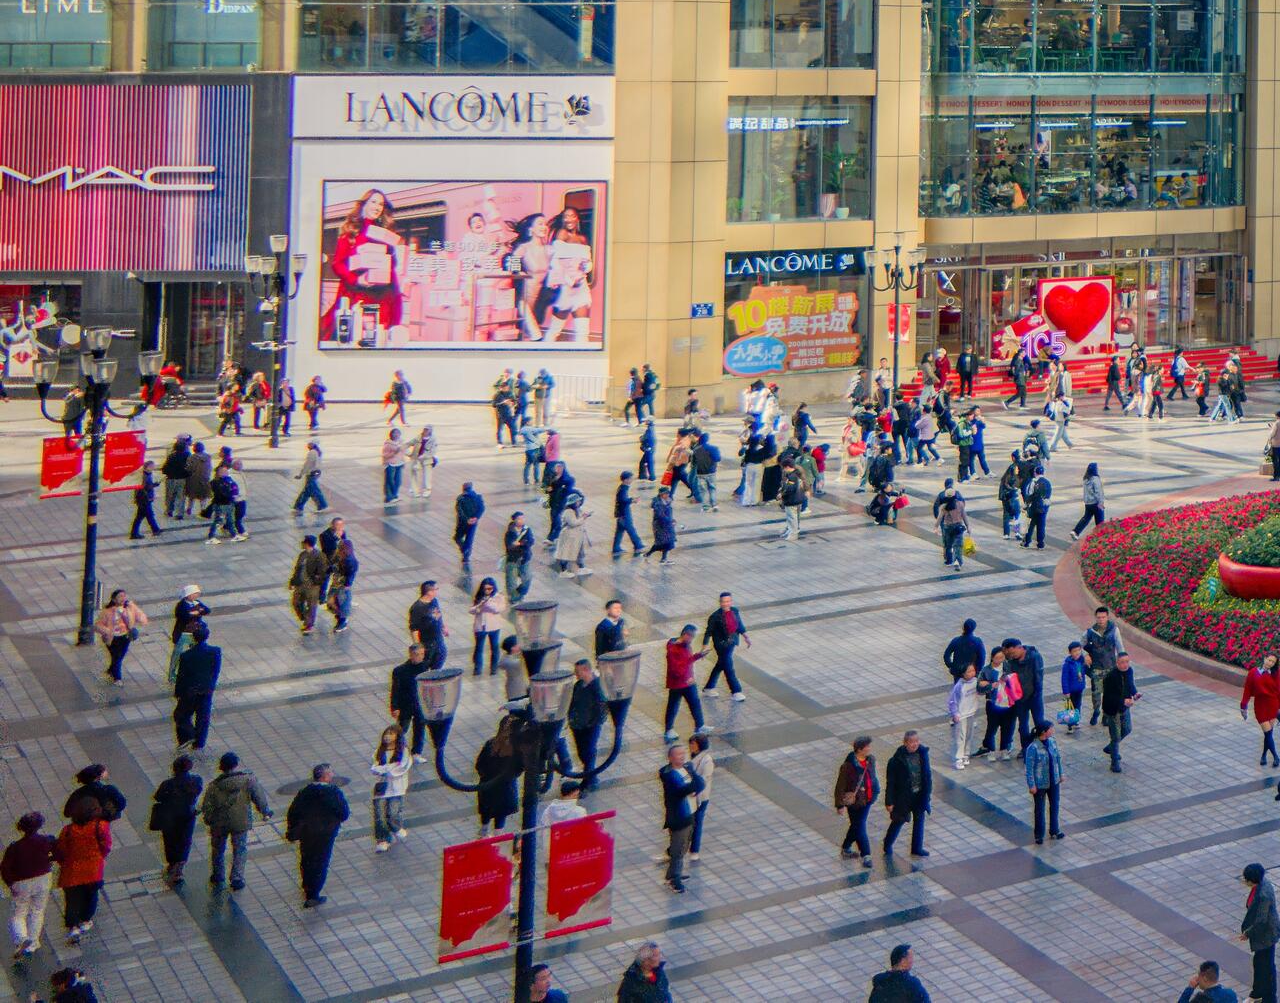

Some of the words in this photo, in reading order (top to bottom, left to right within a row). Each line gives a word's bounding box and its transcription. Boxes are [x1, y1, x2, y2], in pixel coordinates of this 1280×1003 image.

[345, 85, 549, 124] LANCÔME
[727, 252, 834, 275] LANCÔME
[765, 312, 851, 338] 免费开放
